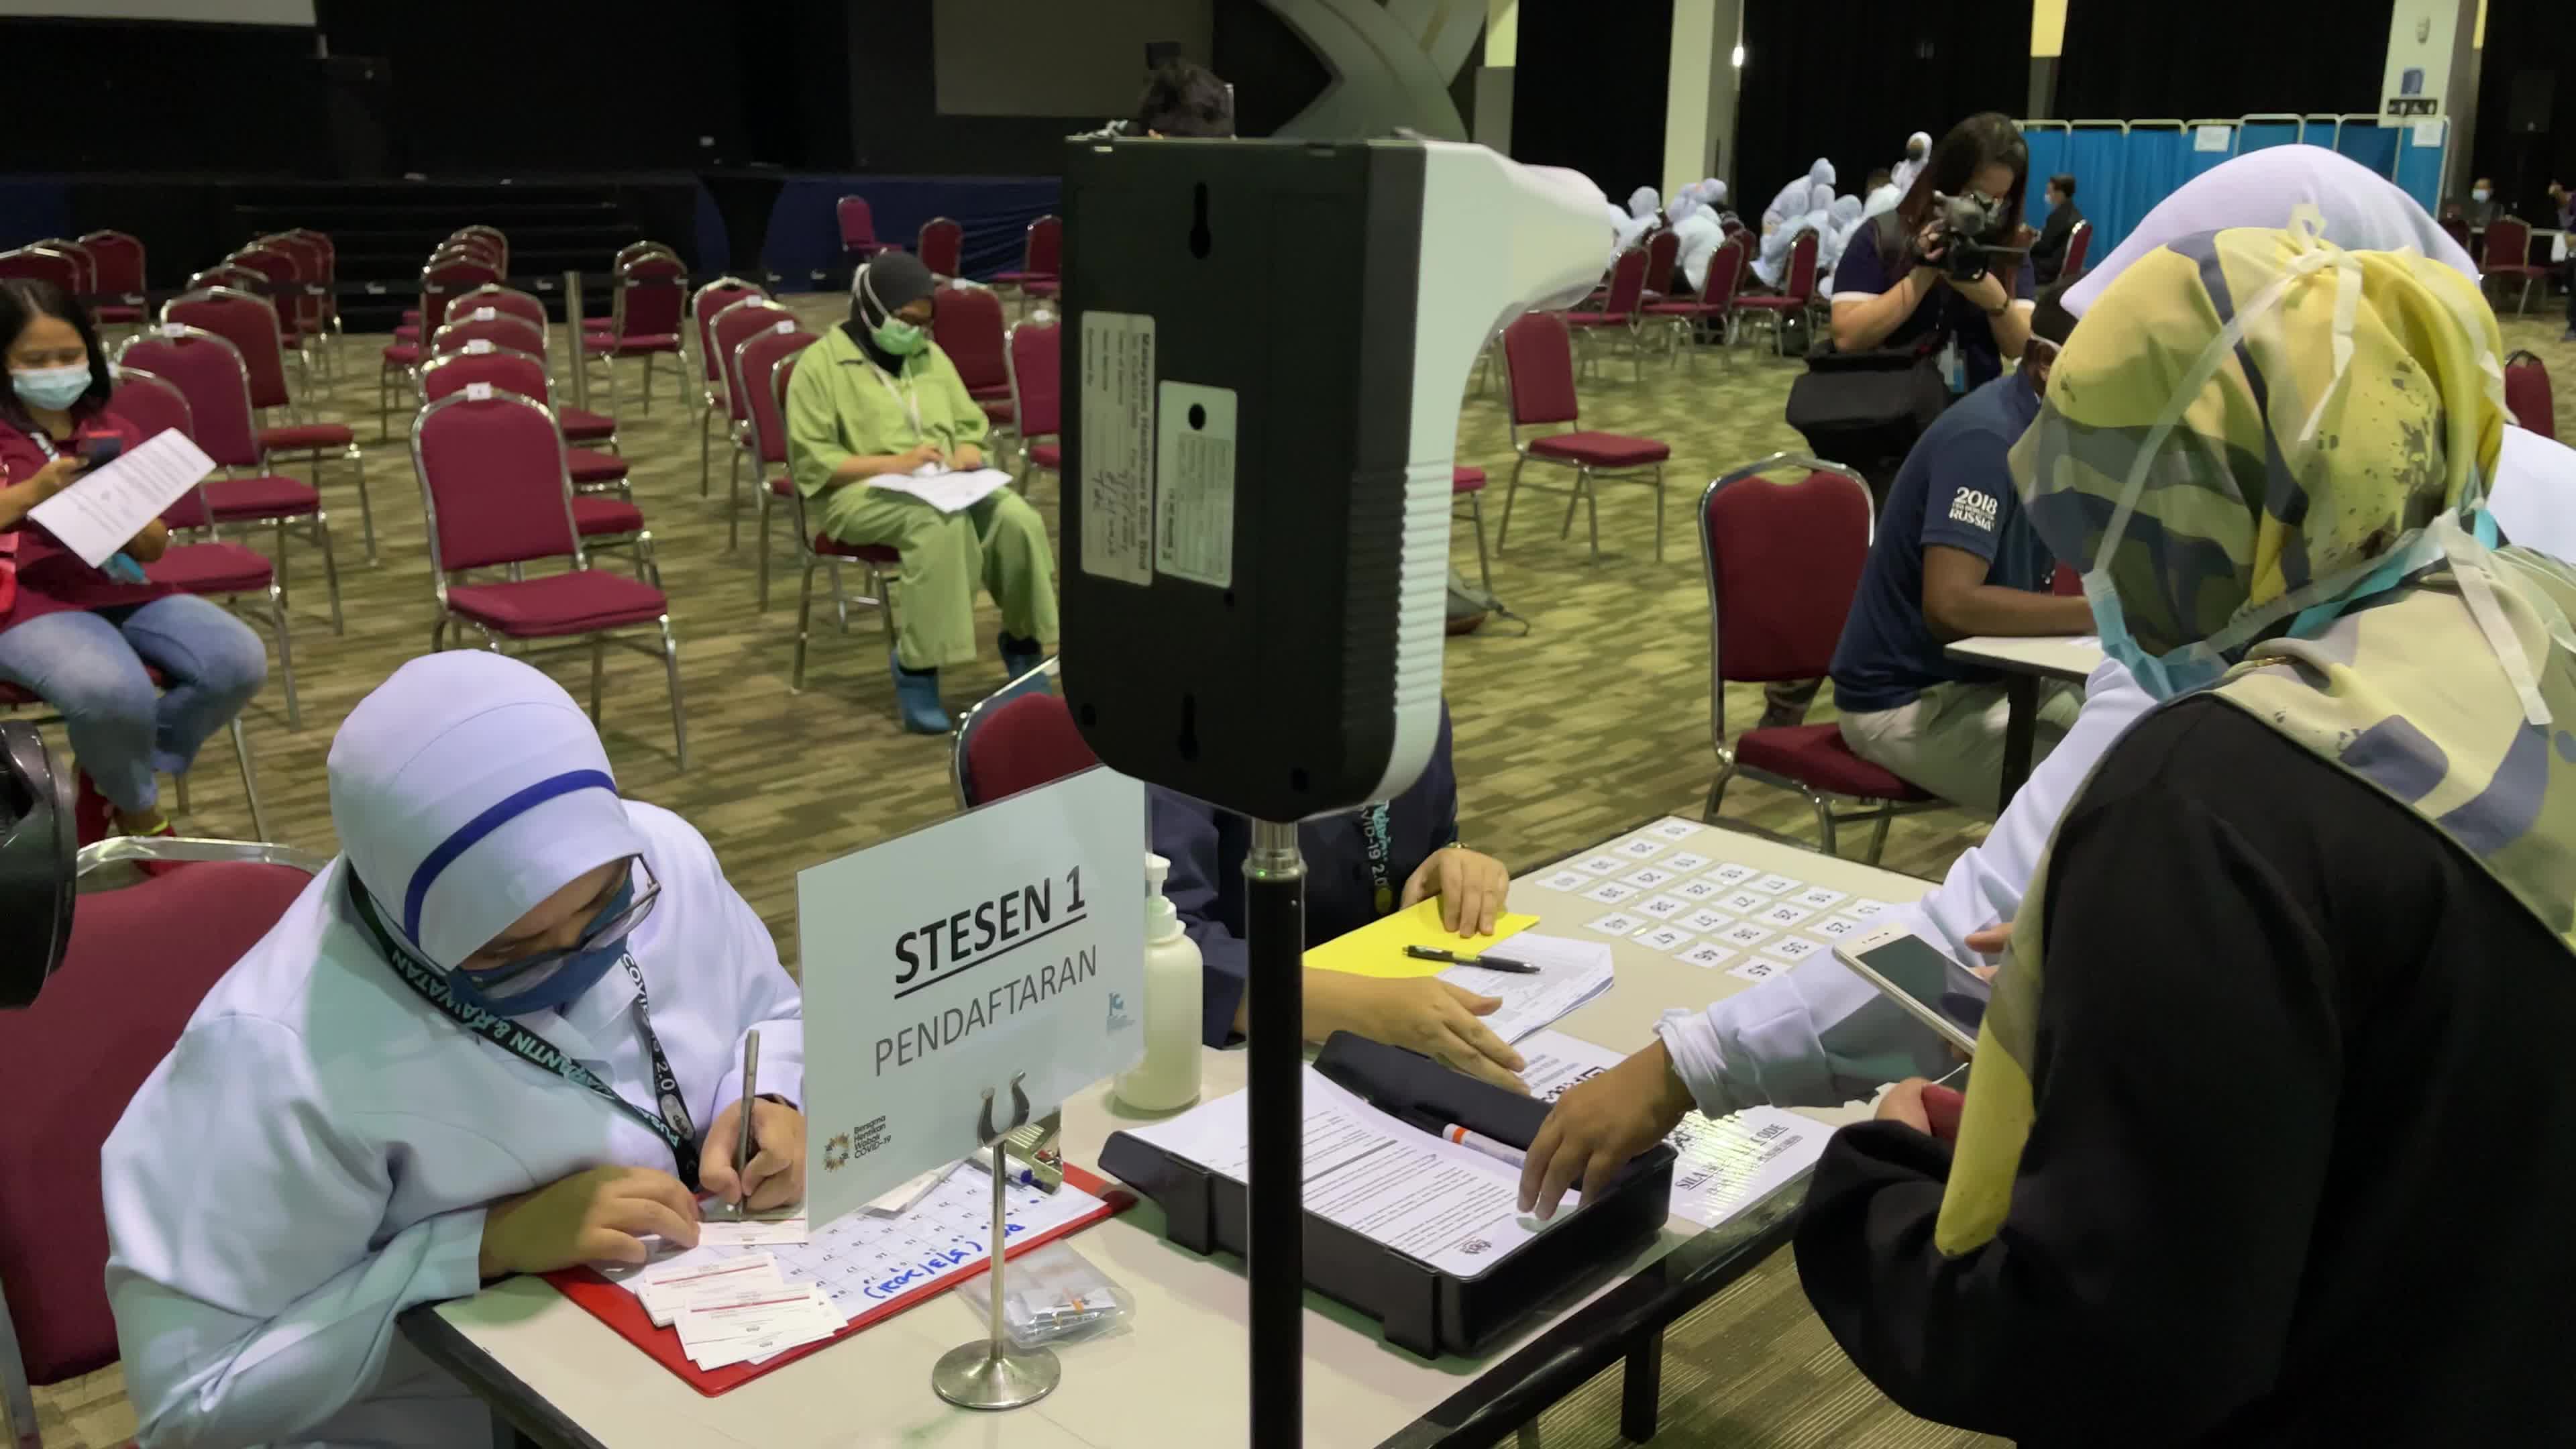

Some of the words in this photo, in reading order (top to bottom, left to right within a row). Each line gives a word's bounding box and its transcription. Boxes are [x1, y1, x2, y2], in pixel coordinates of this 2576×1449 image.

[1953, 486, 1998, 515] 2018
[1949, 502, 1991, 532] RUSSIA
[1361, 807, 1381, 859] VID-19
[896, 877, 1051, 984] STESEN
[1066, 864, 1086, 913] 1
[1826, 922, 1851, 933] 25
[1782, 943, 1809, 953] 35
[1748, 964, 1771, 975] 45
[876, 945, 1097, 1077] PENDAFTARAN
[494, 1019, 511, 1038] &
[510, 1031, 608, 1096] ARANTIN
[655, 1061, 676, 1091] 2.0
[854, 1115, 885, 1134] Bersama
[854, 1133, 880, 1150] Wabak
[855, 1134, 892, 1159] COVID-19
[1675, 1169, 1708, 1189] SILA
[1750, 1122, 1785, 1143] CODE
